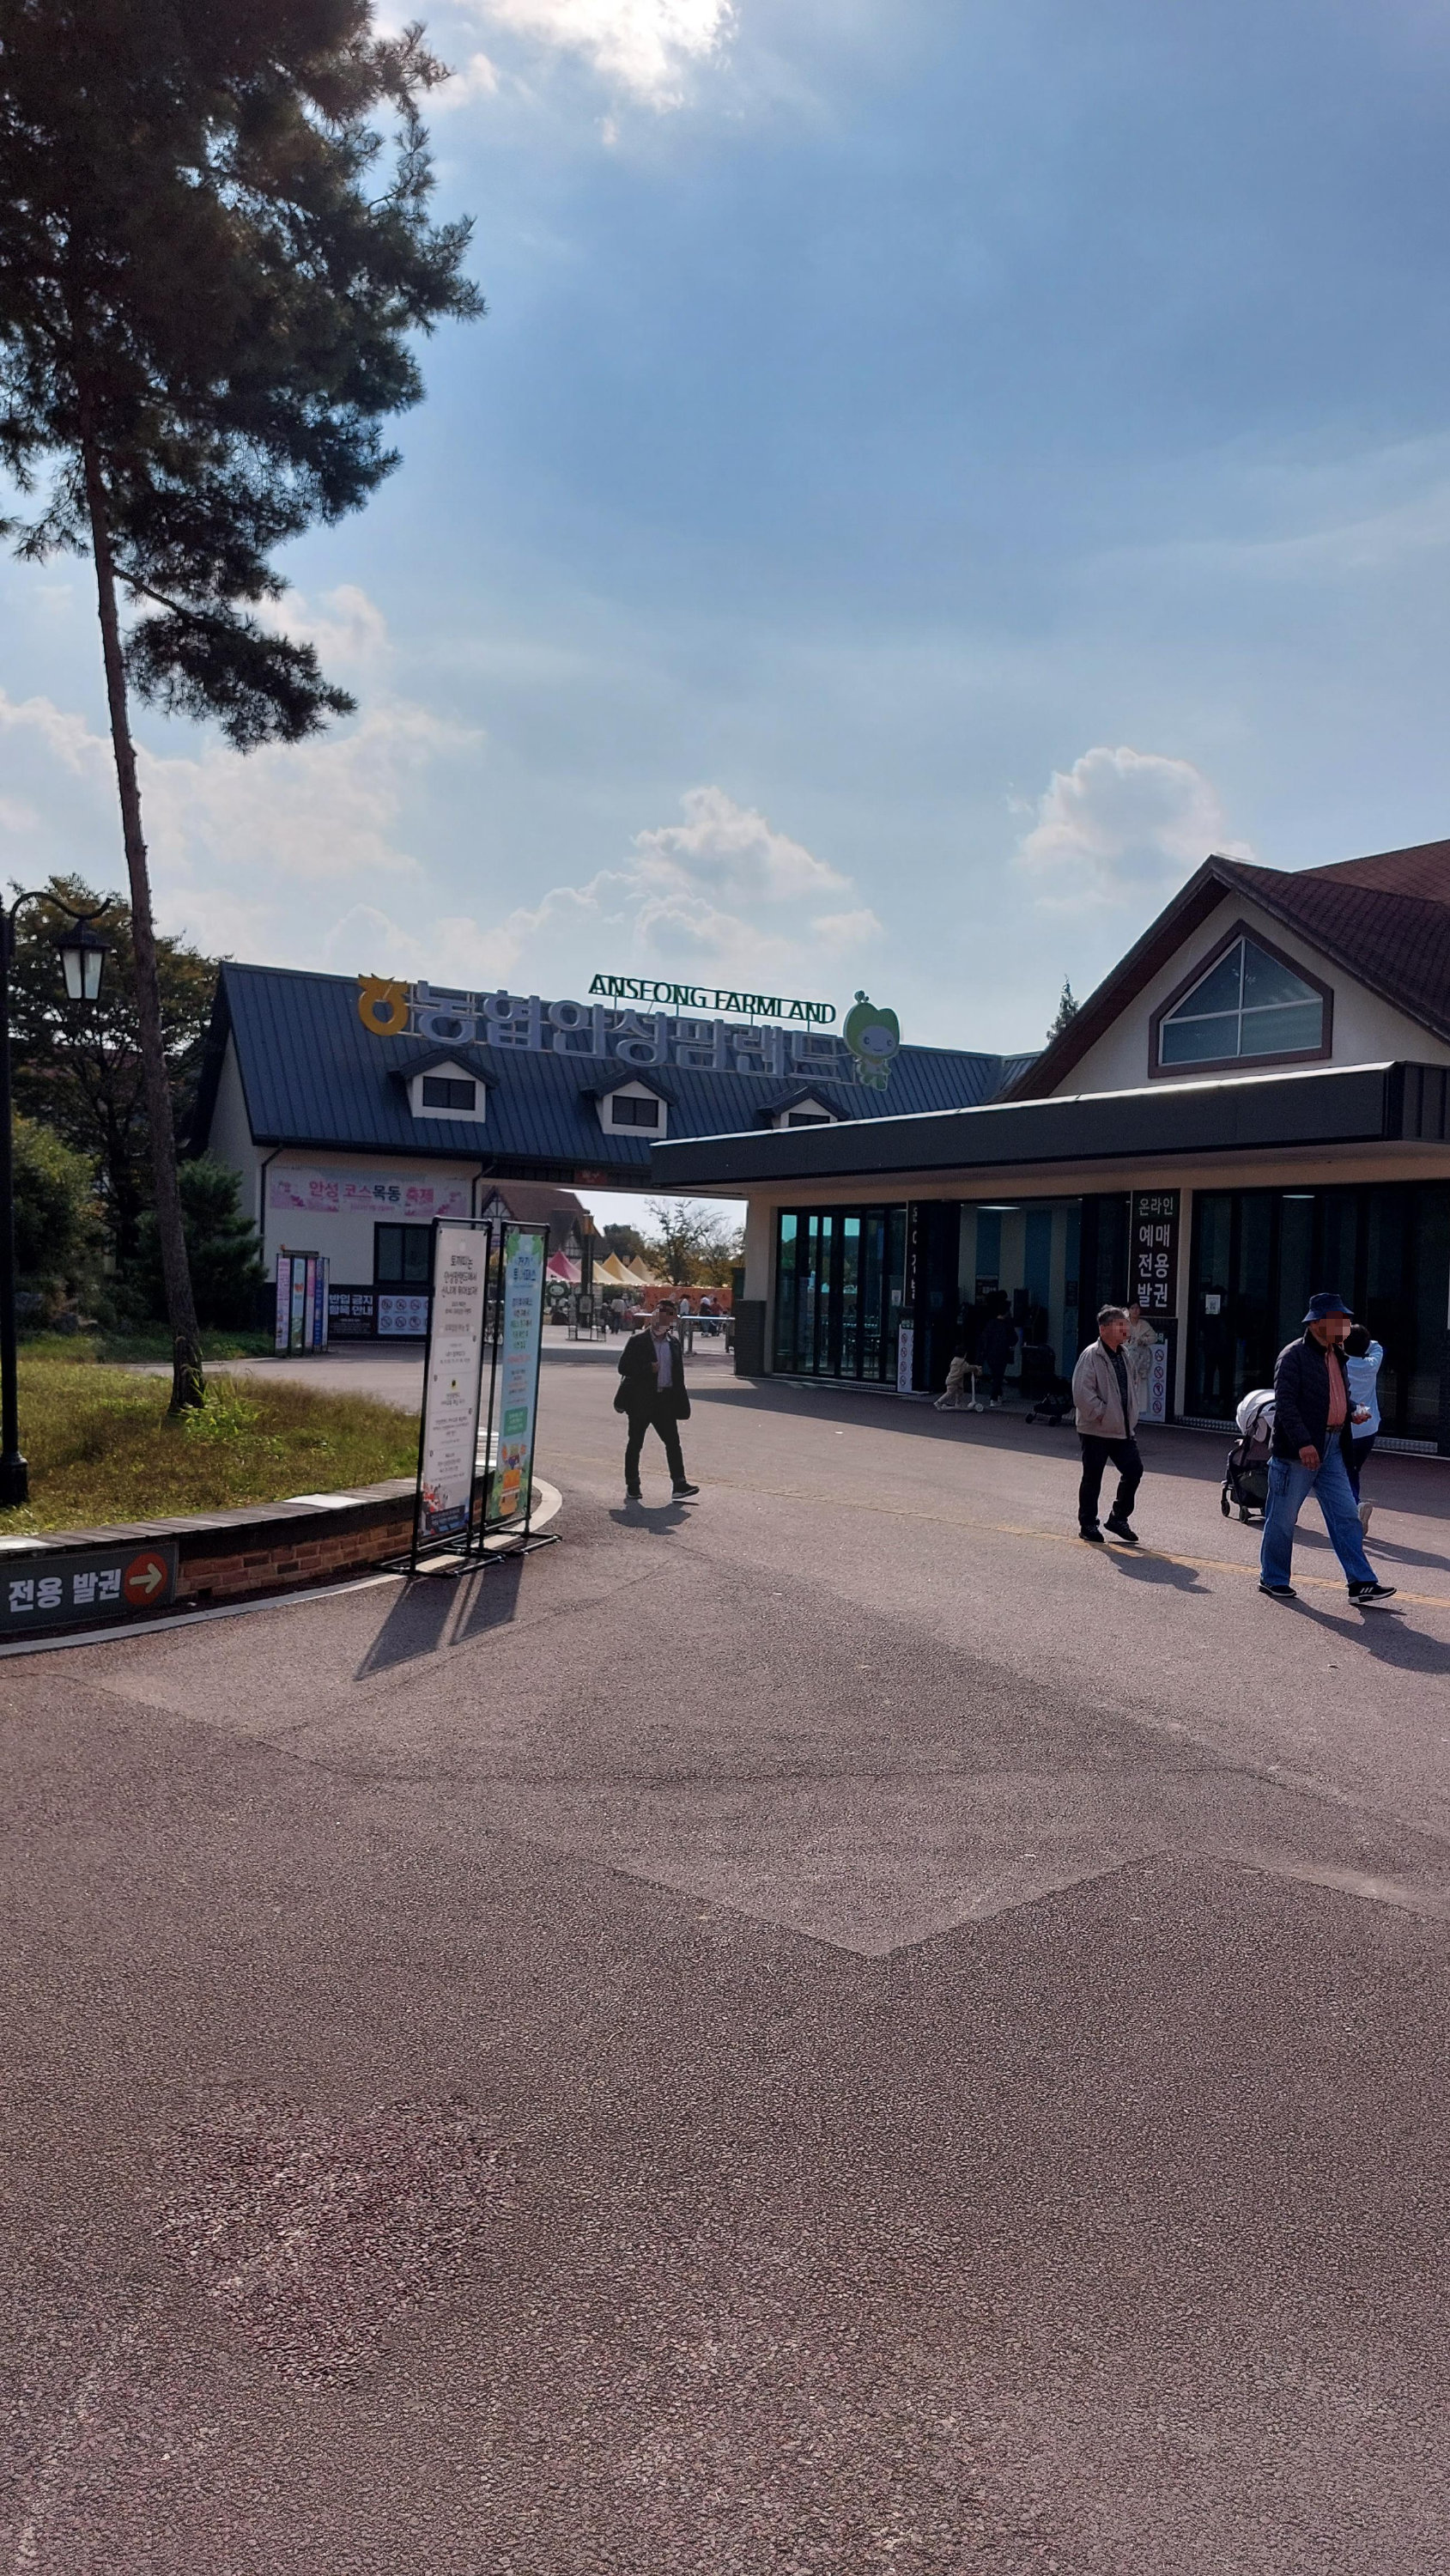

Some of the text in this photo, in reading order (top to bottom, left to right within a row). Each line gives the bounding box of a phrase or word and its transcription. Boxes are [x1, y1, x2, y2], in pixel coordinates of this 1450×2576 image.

[588, 974, 836, 1024] ANSEONG FARMLAND
[309, 1180, 339, 1200] 안성
[1138, 1196, 1174, 1216] 온라인
[1139, 1224, 1170, 1248] 예매
[1138, 1253, 1169, 1278] 전용
[330, 1294, 373, 1305] 반입 금지
[1138, 1283, 1168, 1308] 발권
[352, 1305, 373, 1316] 안내
[9, 1568, 121, 1613] 전용 발권
